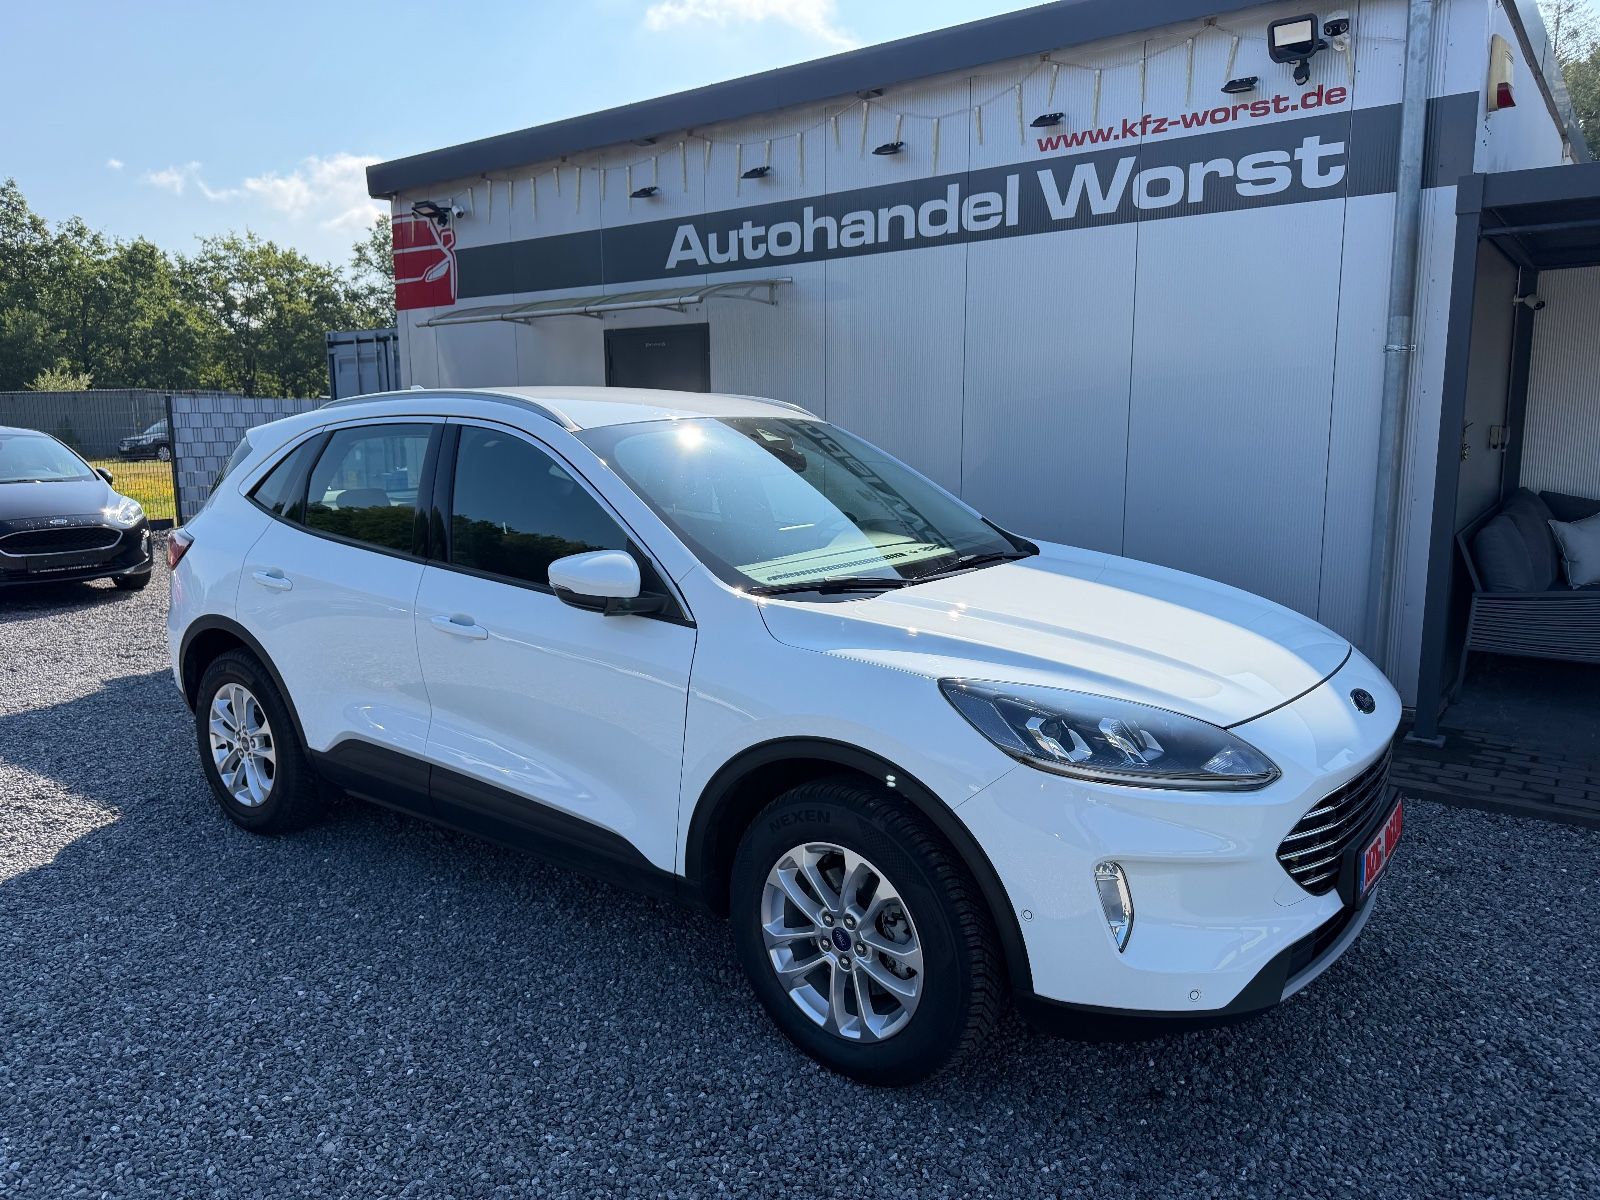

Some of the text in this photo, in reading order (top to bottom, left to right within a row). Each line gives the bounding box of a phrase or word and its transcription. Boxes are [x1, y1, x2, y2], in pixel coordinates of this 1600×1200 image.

[1037, 84, 1348, 152] www.kfz-worst.de
[665, 135, 1346, 270] Autohandel Worst
[768, 809, 831, 833] NEXEN
